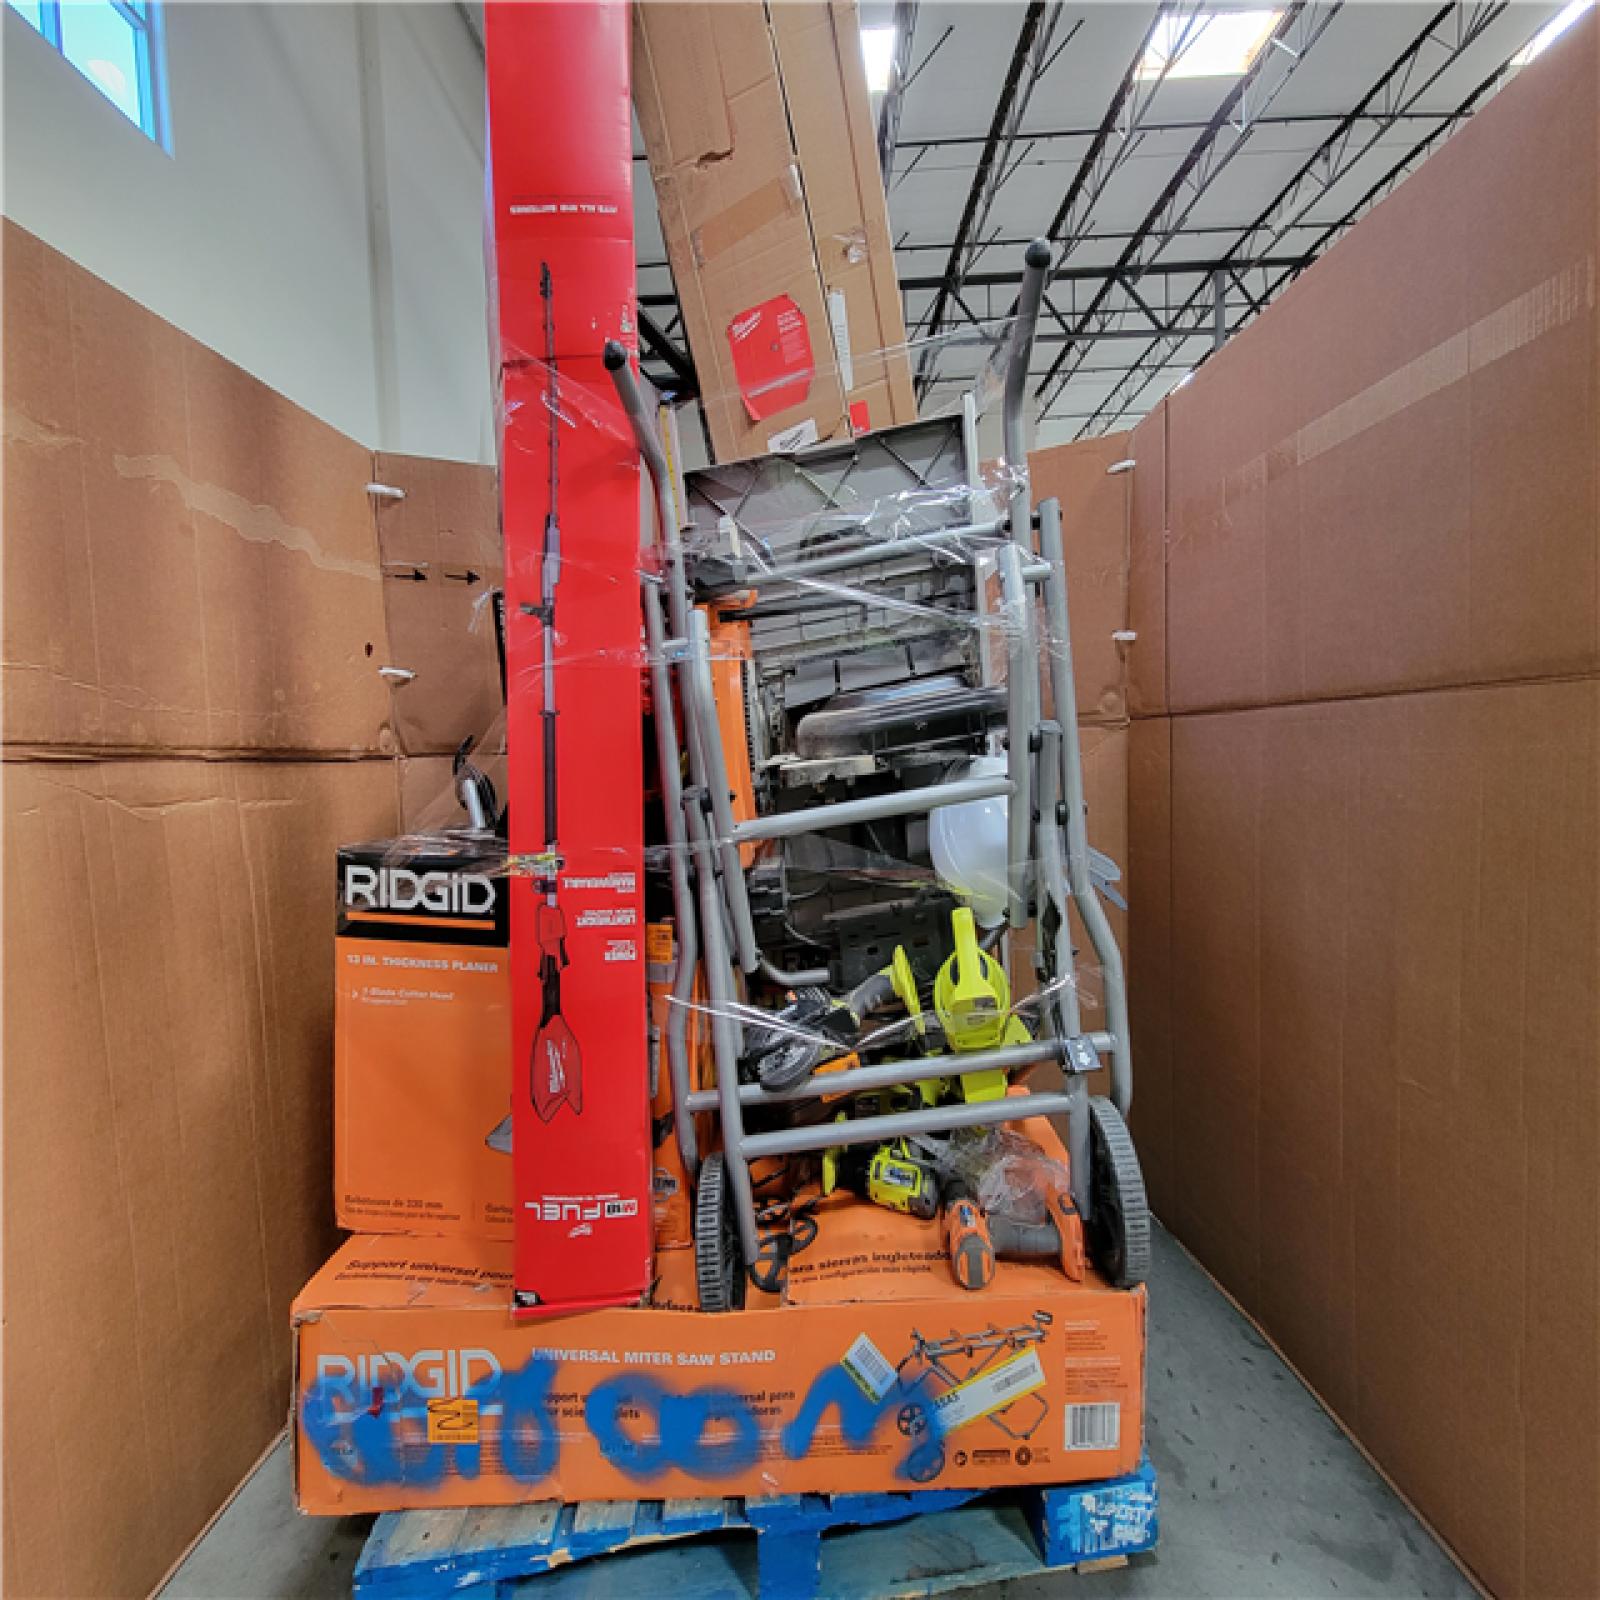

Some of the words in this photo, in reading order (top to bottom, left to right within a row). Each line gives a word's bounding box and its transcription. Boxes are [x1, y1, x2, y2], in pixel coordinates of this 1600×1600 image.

[345, 864, 496, 914] RIDGID
[382, 957, 449, 971] THICKNESS
[452, 960, 498, 974] PLANER
[524, 1201, 601, 1221] FUEL
[345, 1260, 409, 1271] Support
[410, 1261, 480, 1276] universal
[788, 1263, 816, 1274] ara
[532, 1347, 621, 1365] UNIVERSAL
[624, 1351, 673, 1365] MITER
[676, 1352, 716, 1367] SAW
[719, 1348, 777, 1366] STAND
[316, 1349, 502, 1399] RIDGID
